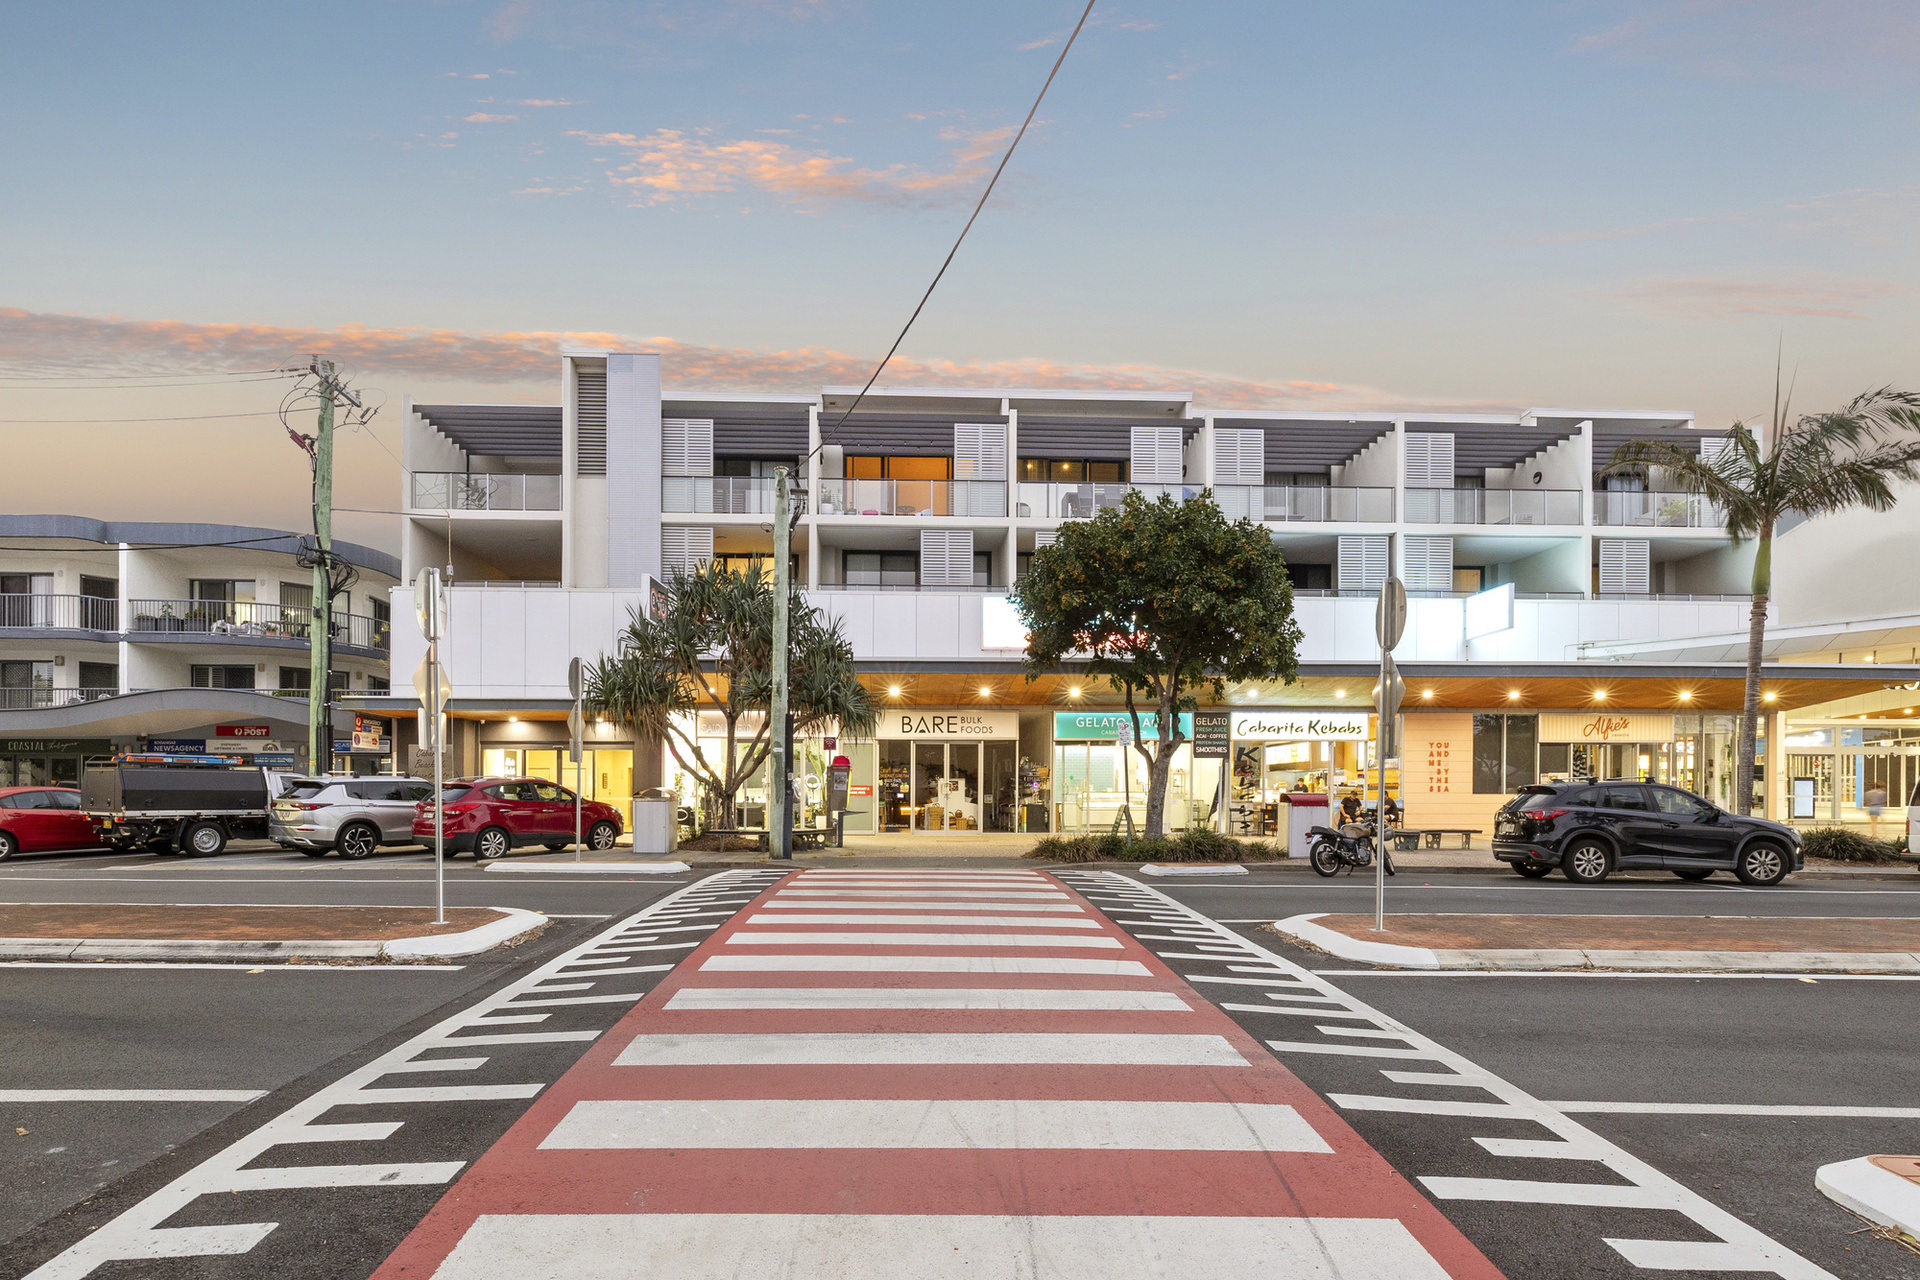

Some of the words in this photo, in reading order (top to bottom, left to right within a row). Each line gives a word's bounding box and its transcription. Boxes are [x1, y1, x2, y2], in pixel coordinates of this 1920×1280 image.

[960, 716, 983, 724] BULK
[1196, 717, 1228, 726] GELATO
[901, 716, 958, 734] BARE
[960, 725, 994, 734] FOODS
[1237, 719, 1304, 737] Cabarita
[1308, 719, 1364, 736] Kebabs
[1583, 716, 1630, 740] Alfie's
[243, 728, 267, 736] POST
[8, 741, 45, 751] COASTAL
[1428, 750, 1450, 758] AND
[1437, 768, 1450, 776] BY
[1428, 785, 1450, 793] SEA
